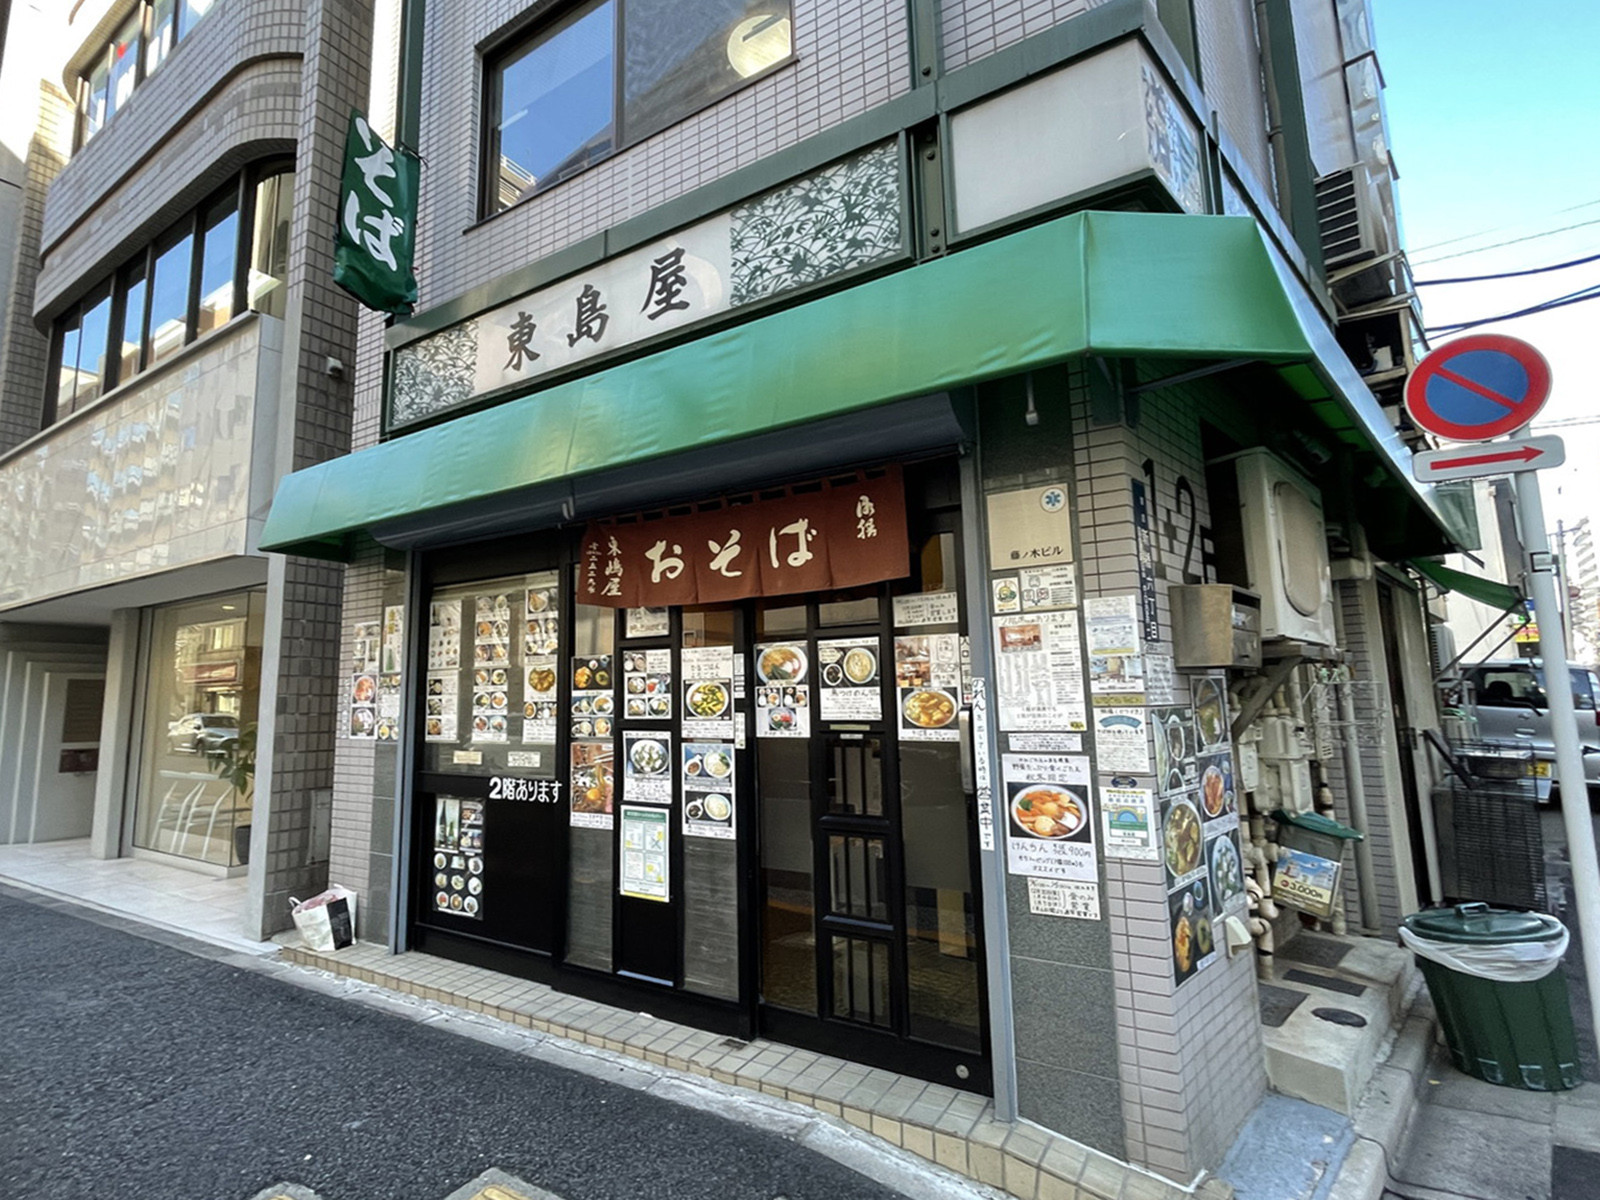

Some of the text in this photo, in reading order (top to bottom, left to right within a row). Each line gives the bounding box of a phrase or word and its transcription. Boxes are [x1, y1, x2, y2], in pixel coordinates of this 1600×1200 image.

[344, 117, 404, 271] そば
[503, 247, 690, 371] 東島屋
[645, 518, 818, 583] おそば
[489, 776, 563, 803] 2階あります
